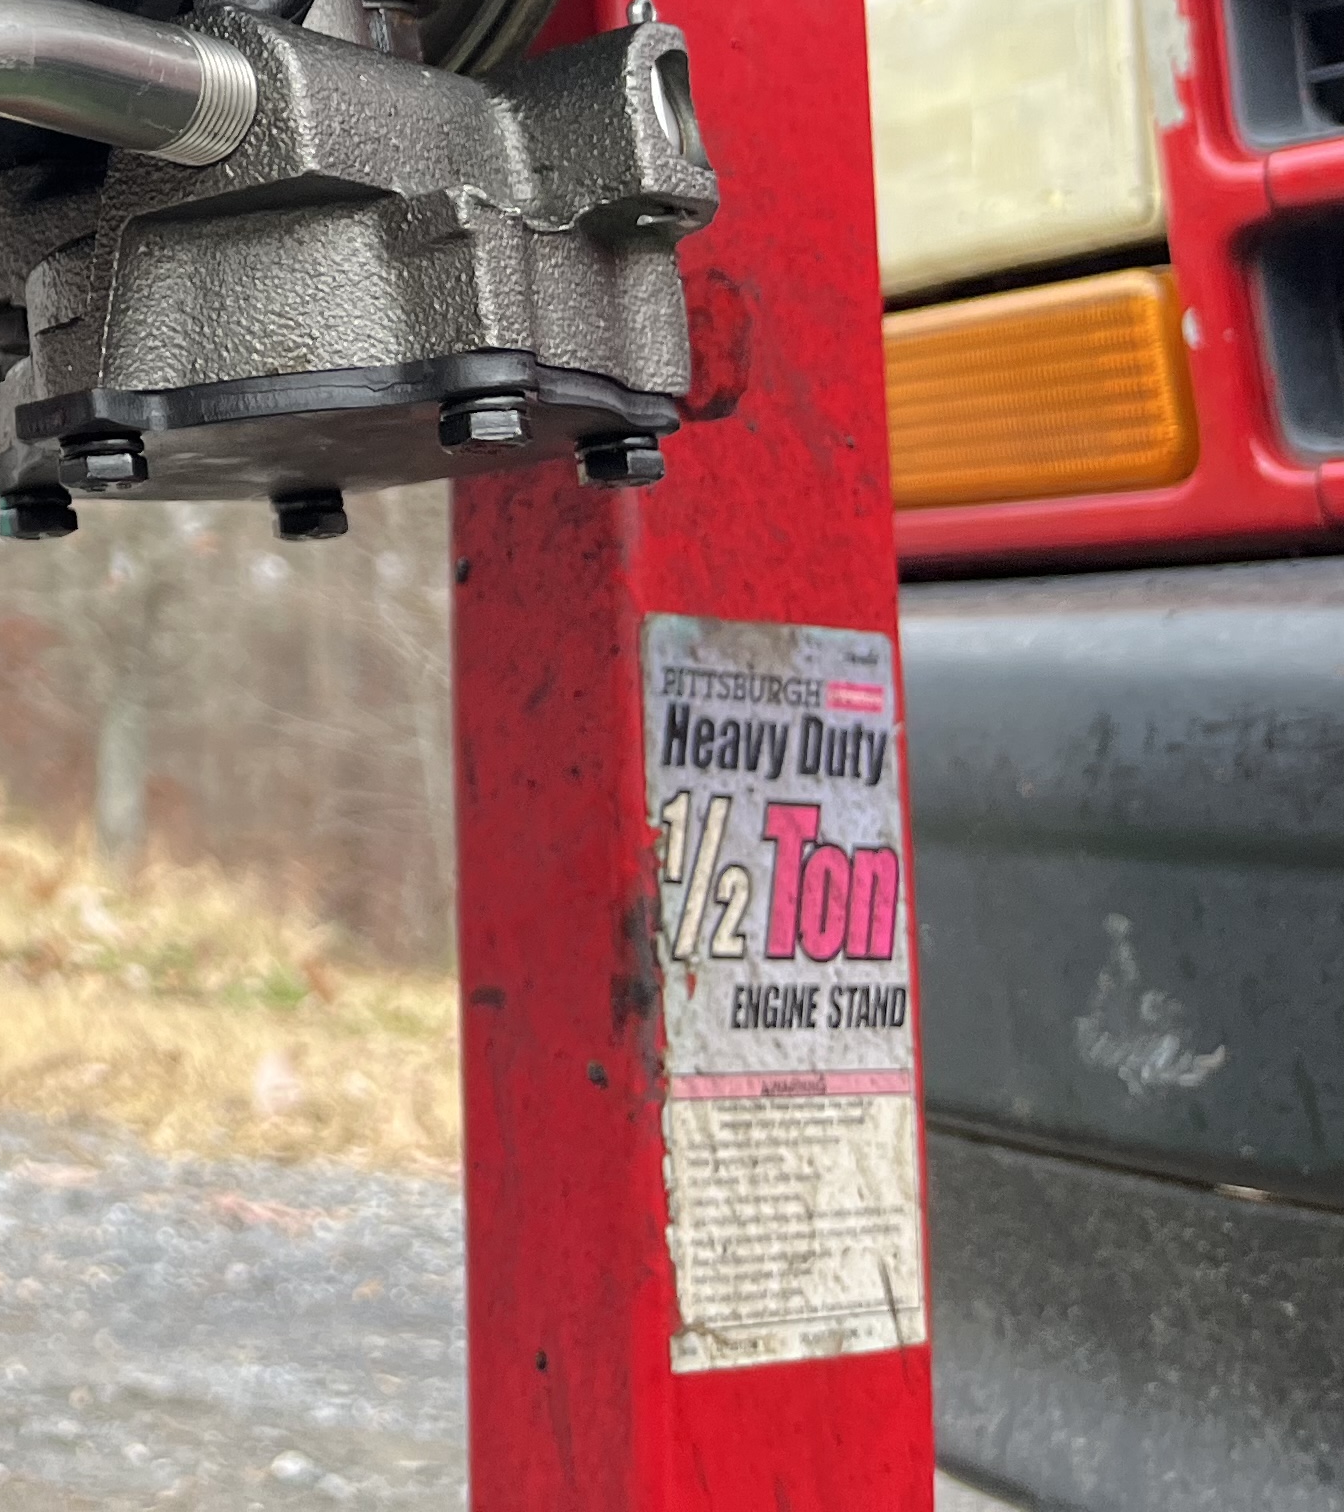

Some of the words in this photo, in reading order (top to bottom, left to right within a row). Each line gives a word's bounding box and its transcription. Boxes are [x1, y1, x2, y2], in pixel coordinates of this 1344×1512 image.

[661, 666, 822, 708] PITTSBURGH
[661, 703, 789, 780] Heavy
[798, 716, 887, 786] Duty
[763, 801, 900, 962] Ton
[731, 984, 821, 1030] ENGINE
[827, 984, 907, 1029] STAND
